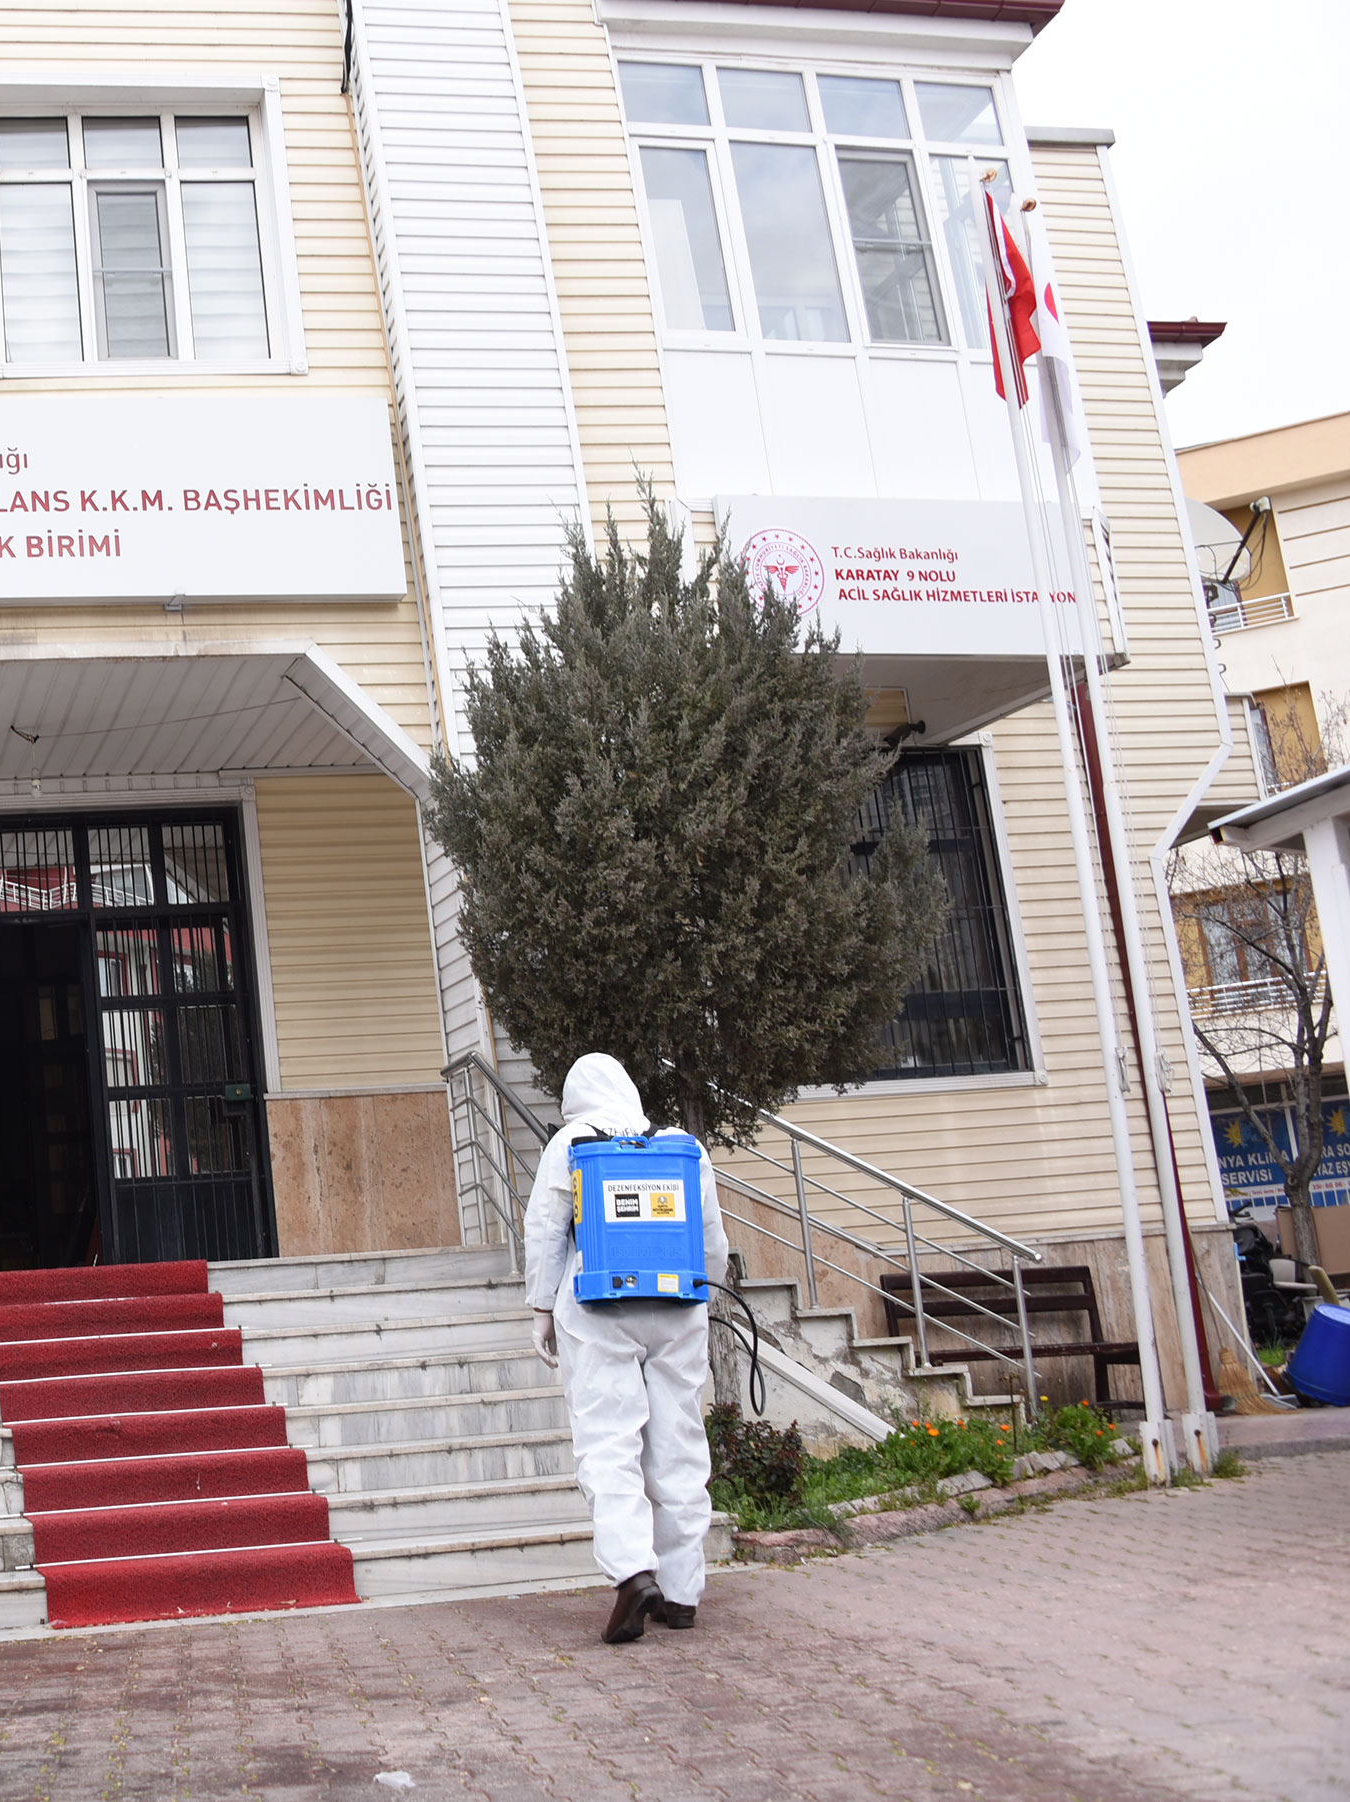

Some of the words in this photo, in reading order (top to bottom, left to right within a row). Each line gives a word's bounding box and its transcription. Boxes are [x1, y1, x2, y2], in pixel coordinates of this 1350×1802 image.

[80, 489, 174, 512] K.K.M.
[183, 482, 393, 515] BAŞHEKİMLİĞİ
[25, 528, 122, 558] BİRİMİ
[899, 547, 959, 564] Bakanlığı
[834, 568, 900, 581] KARATAY
[906, 570, 915, 582] 9
[918, 570, 956, 582] NOLU
[838, 585, 870, 601] ACİL
[872, 586, 924, 602] SAĞLIK
[925, 587, 1008, 603] HİZMETLERİ
[1010, 588, 1077, 604] İSTAYON
[1218, 1155, 1245, 1169] NYA
[607, 1183, 661, 1192] DEZENFEKSİYON
[662, 1182, 679, 1192] EKİBİ
